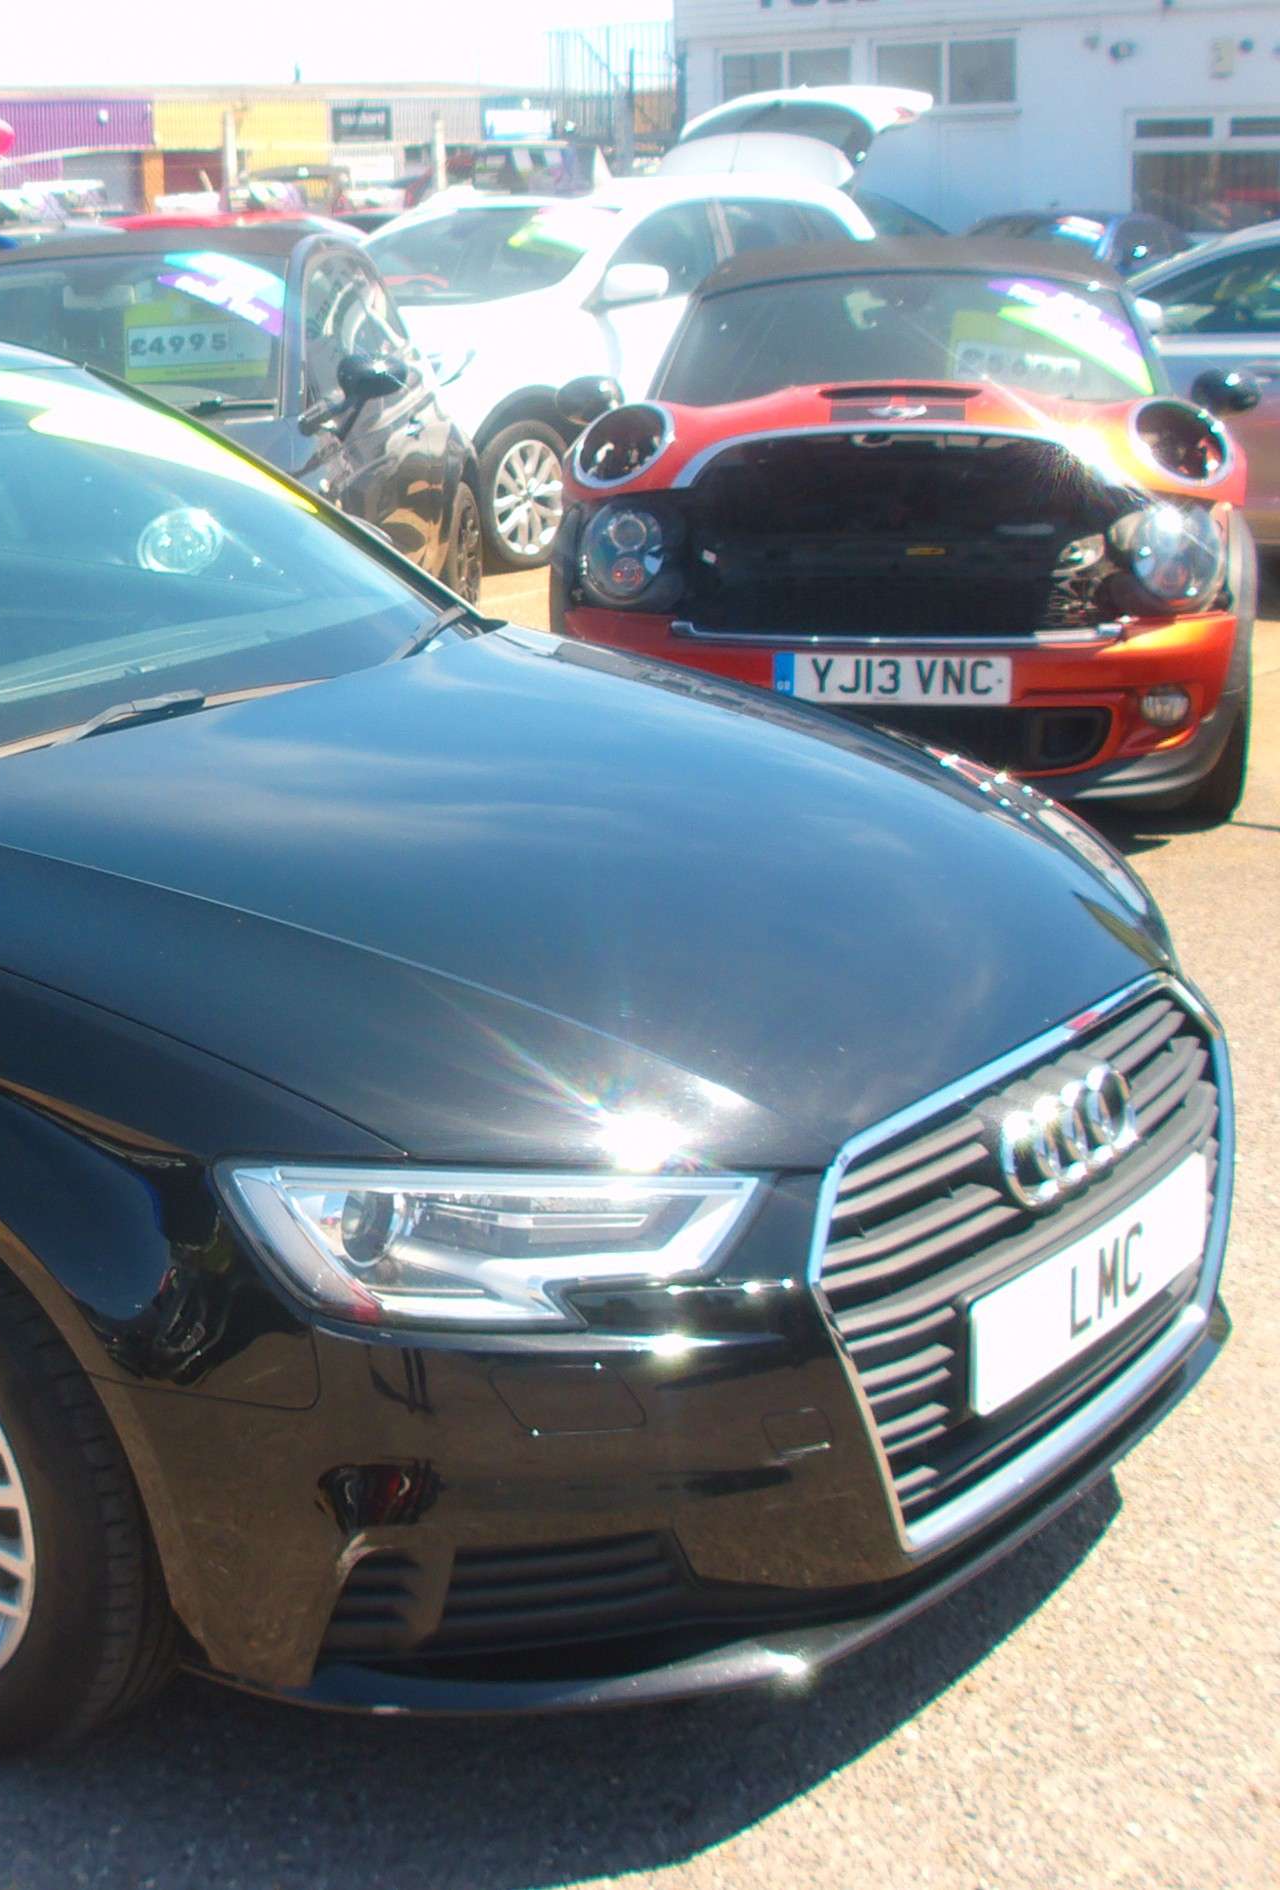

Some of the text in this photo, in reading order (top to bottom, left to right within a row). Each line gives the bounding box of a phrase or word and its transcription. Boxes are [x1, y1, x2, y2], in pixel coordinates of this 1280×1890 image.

[130, 332, 227, 357] £4995
[811, 657, 993, 696] YJ13 VNC
[1070, 1221, 1143, 1340] LMC
